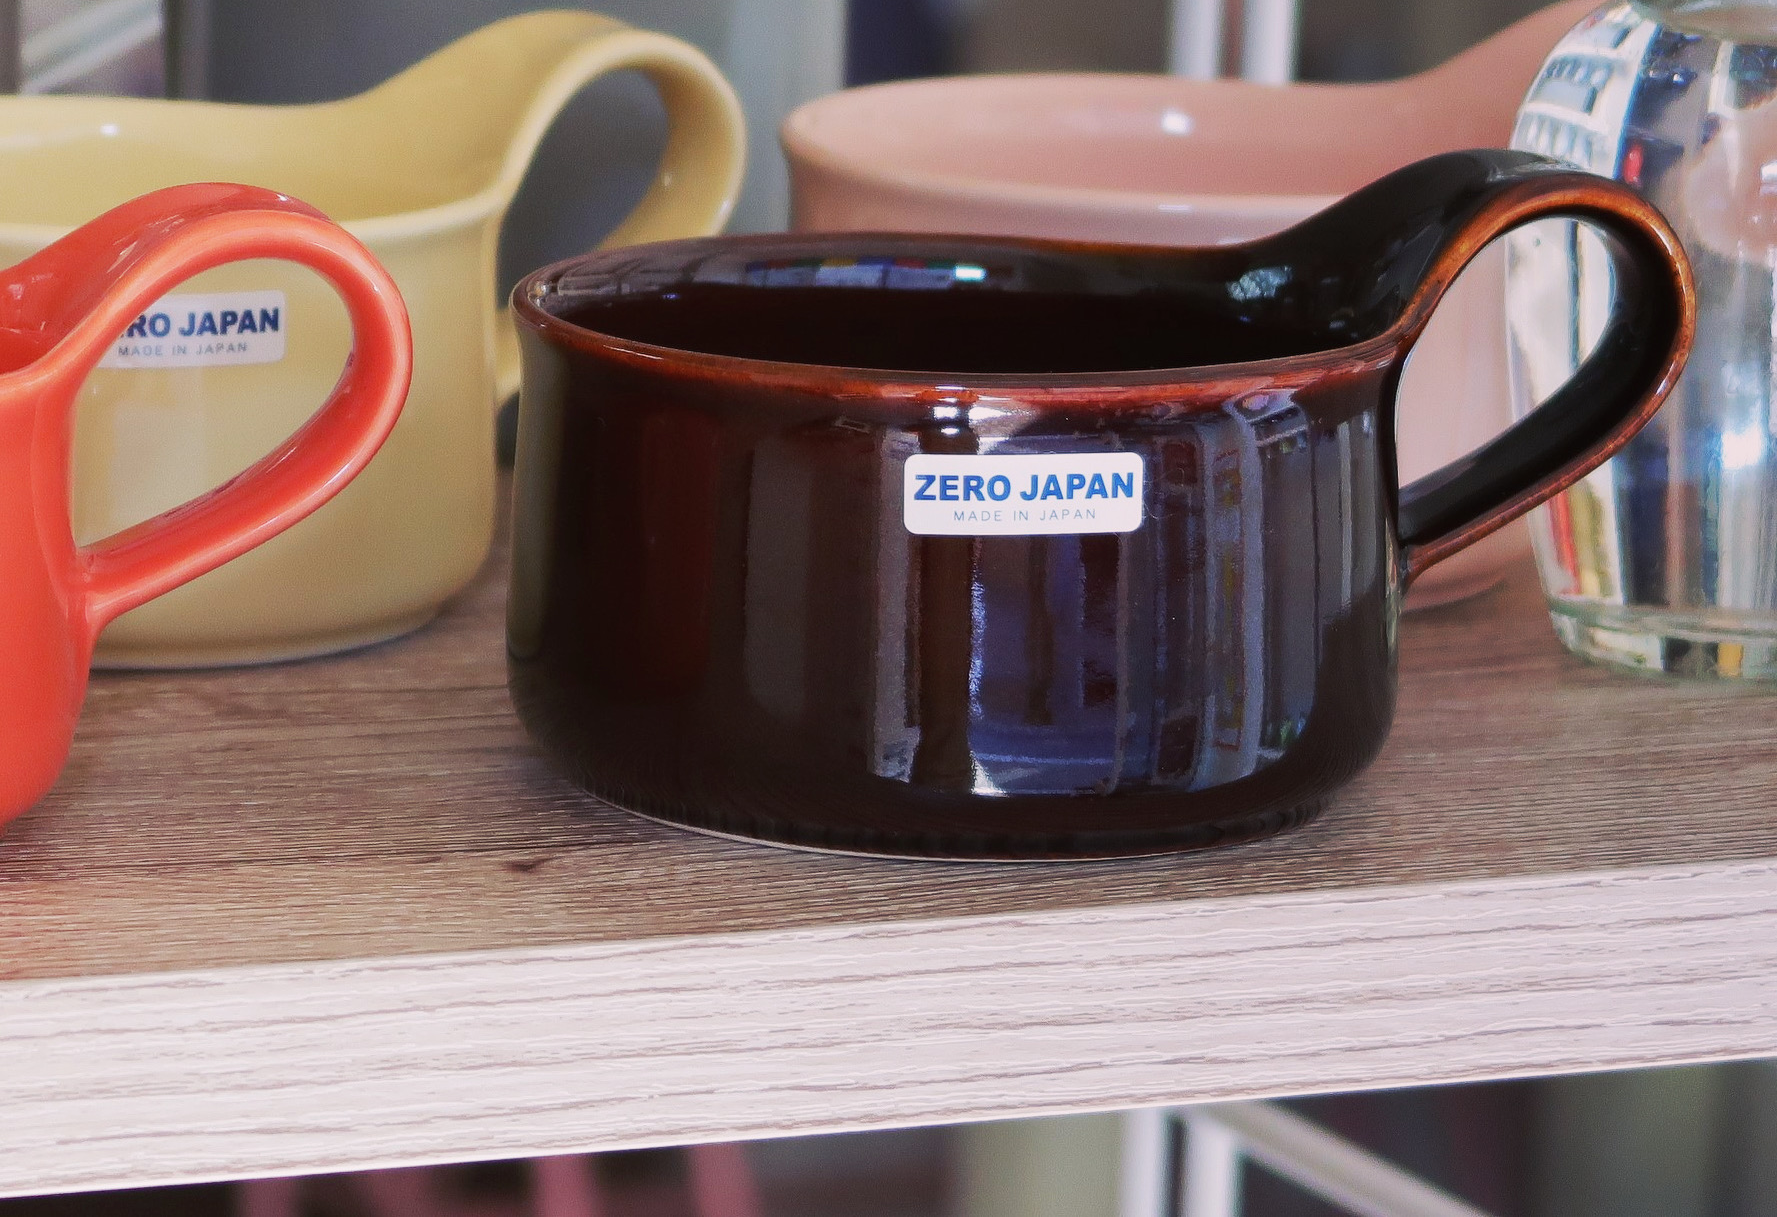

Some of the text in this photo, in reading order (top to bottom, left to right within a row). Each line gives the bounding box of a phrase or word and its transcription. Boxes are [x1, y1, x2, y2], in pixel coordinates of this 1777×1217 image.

[121, 307, 280, 338] RO JAPAN
[118, 341, 248, 356] MADE IN JAPAN
[913, 472, 1134, 501] ZERO JAPAN
[953, 509, 1096, 521] MADE IN JAPAN
